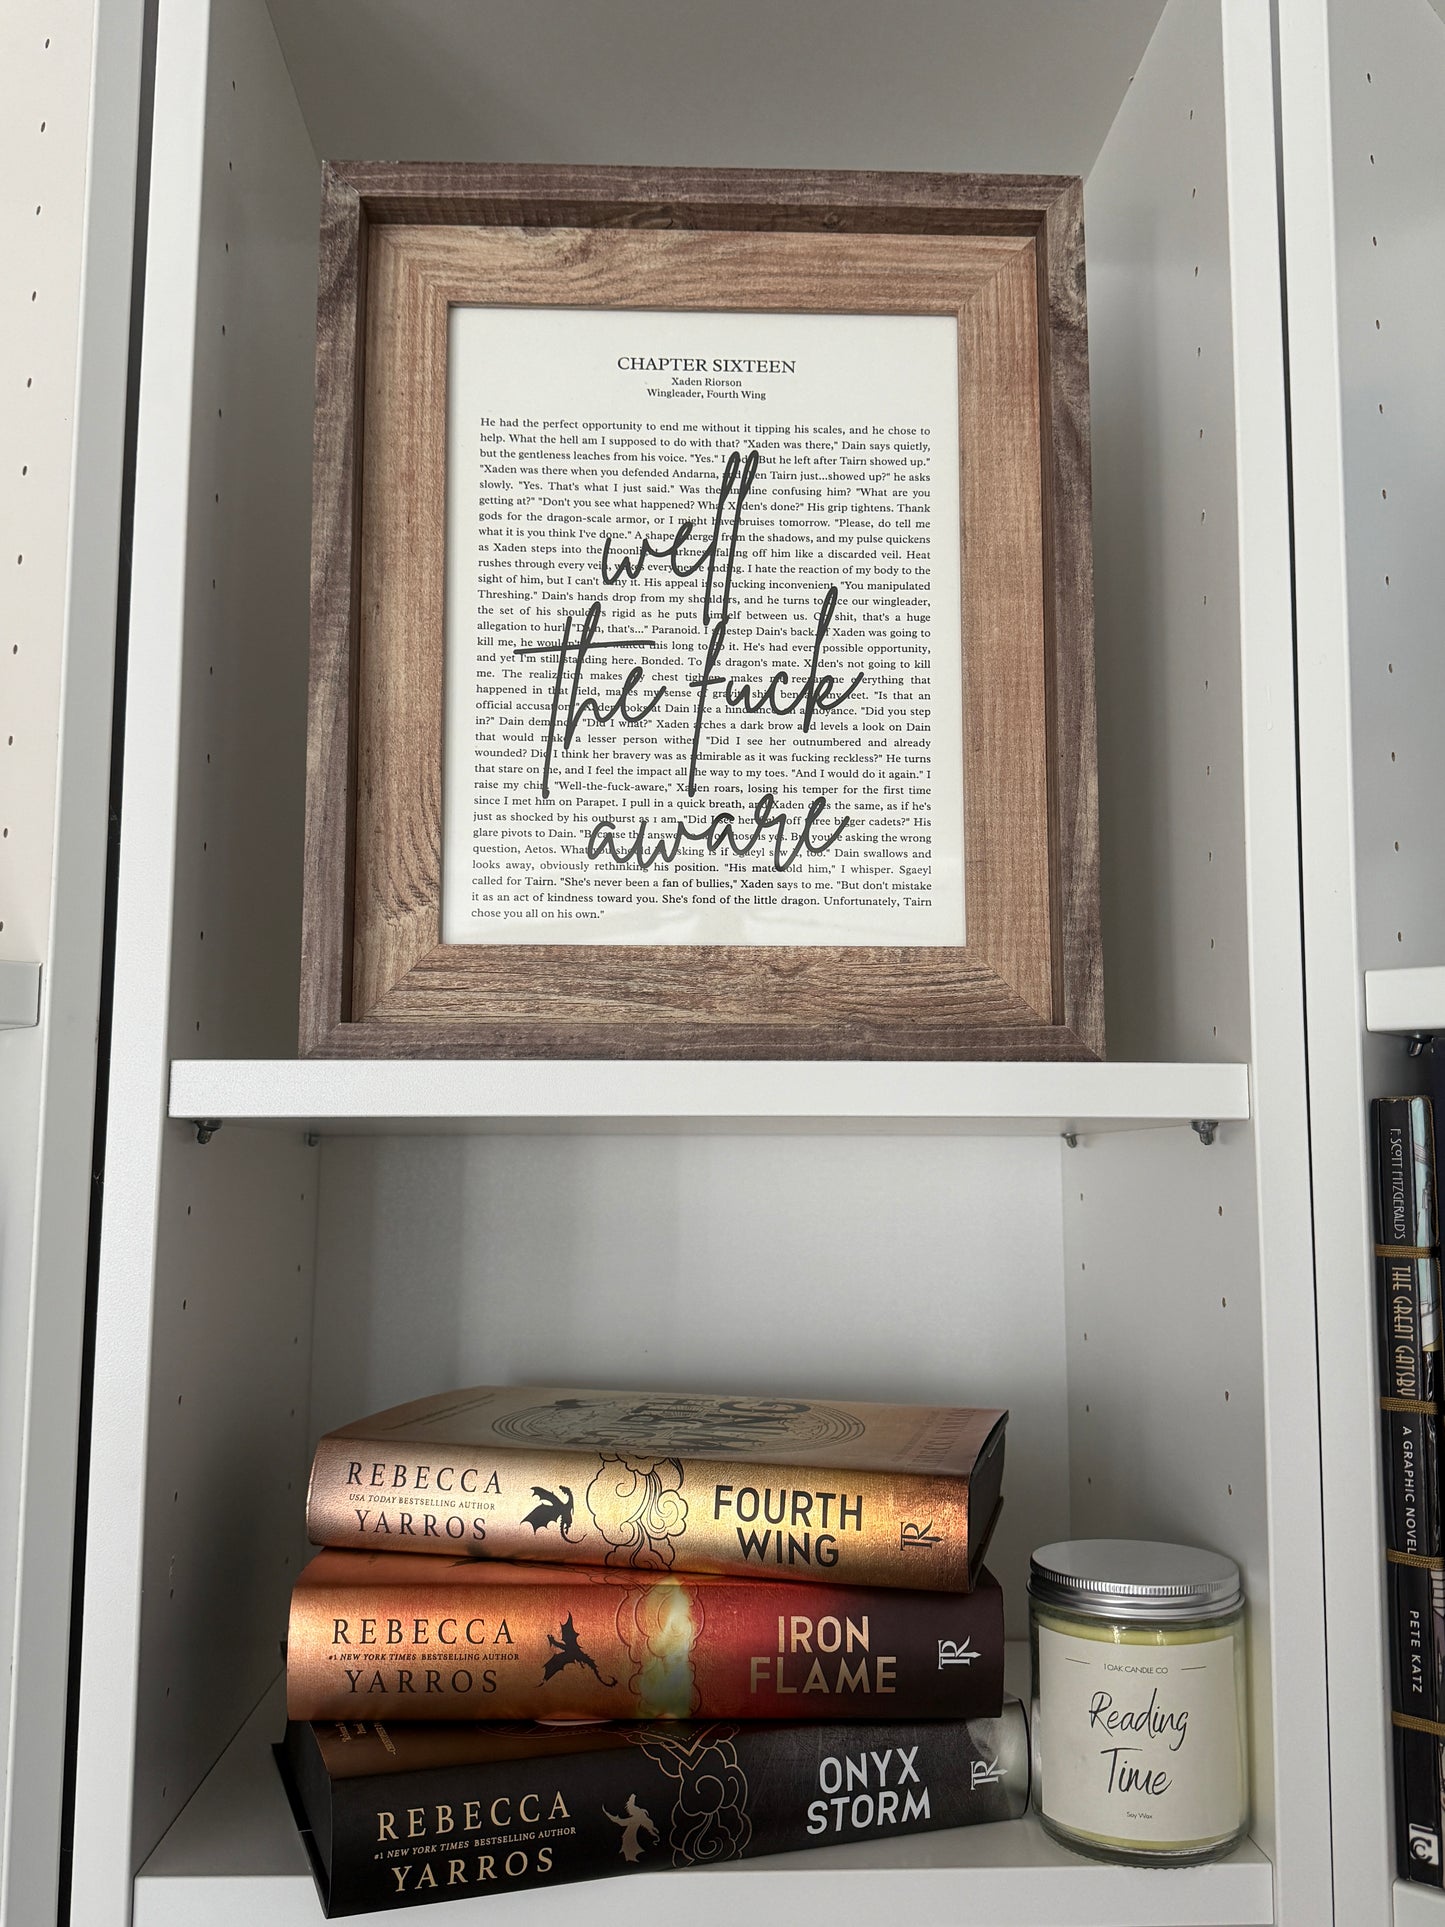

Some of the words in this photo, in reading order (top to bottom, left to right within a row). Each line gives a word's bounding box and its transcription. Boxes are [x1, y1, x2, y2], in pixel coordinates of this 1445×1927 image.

[617, 356, 708, 372] CHAPTER
[712, 358, 797, 374] SIXTEEN
[671, 377, 702, 387] Xaden
[704, 377, 742, 387] Riorson
[647, 388, 704, 399] Wingleader,
[706, 389, 739, 399] Fourth
[741, 390, 767, 401] Wing
[480, 417, 496, 427] He
[499, 418, 519, 427] had
[522, 418, 539, 428] the
[542, 419, 579, 431] perfect
[582, 419, 643, 432] opportunity
[646, 421, 657, 430] to
[659, 421, 680, 430] end
[701, 422, 741, 432] without
[743, 423, 752, 432] it
[755, 423, 791, 435] tipping
[794, 424, 810, 433] his
[813, 424, 846, 435] scales,
[849, 425, 869, 434] and
[872, 425, 885, 435] he
[888, 426, 917, 435] chose
[920, 426, 931, 436] to
[480, 433, 506, 445] help.
[508, 433, 537, 443] What
[540, 434, 557, 444] the
[559, 434, 579, 444] hell
[601, 435, 606, 444] I
[609, 435, 657, 448] supposed
[660, 436, 671, 446] to
[673, 437, 687, 446] do
[689, 437, 712, 447] with
[715, 437, 740, 447] that?
[743, 438, 781, 448] "Xaden
[805, 439, 839, 450] there,"
[841, 440, 867, 450] Dain
[869, 443, 891, 452] says
[893, 441, 931, 453] quietly,
[602, 450, 759, 625] well
[513, 601, 666, 798] the
[688, 587, 864, 798] fuck
[474, 779, 499, 789] raise
[503, 782, 520, 791] my
[554, 780, 672, 792] "Well-the-fuck-aware,"
[714, 785, 744, 793] roars,
[747, 783, 779, 795] losing
[782, 783, 798, 793] his
[801, 783, 839, 796] temper
[843, 784, 859, 794] for
[862, 784, 879, 794] the
[883, 785, 905, 794] first
[908, 785, 932, 795] time
[587, 794, 850, 873] aware
[471, 876, 503, 885] called
[506, 876, 522, 886] for
[524, 876, 557, 886] Tairn.
[560, 877, 591, 886] "She's
[625, 877, 650, 887] been
[662, 878, 680, 887] fan
[682, 878, 695, 888] of
[695, 878, 738, 889] bullies,"
[740, 879, 774, 889] Xaden
[777, 882, 799, 891] says
[801, 879, 812, 889] to
[836, 880, 860, 889] "But
[862, 880, 889, 890] don't
[892, 880, 932, 890] mistake
[471, 892, 480, 901] it
[513, 892, 530, 902] act
[532, 892, 545, 902] of
[547, 893, 594, 903] kindness
[597, 893, 633, 903] toward
[636, 896, 659, 906] you.
[662, 894, 689, 904] She's
[692, 894, 717, 904] fond
[719, 894, 732, 904] of
[733, 895, 751, 904] the
[754, 895, 778, 905] little
[780, 895, 820, 907] dragon.
[823, 896, 900, 908] Unfortunately,
[902, 896, 932, 906] Tairn
[471, 908, 502, 918] chose
[503, 911, 523, 920] you
[525, 908, 539, 918] all
[557, 909, 573, 918] his
[575, 909, 605, 919] own."
[1392, 1171, 1406, 1240] FITZGERALD'S
[1392, 1265, 1412, 1291] THE
[1393, 1295, 1414, 1341] GREAT
[1395, 1345, 1416, 1397] GATSBY
[1402, 1426, 1412, 1435] A
[346, 1461, 503, 1494] REBECCA
[1403, 1441, 1415, 1503] GRAPHIC
[349, 1493, 366, 1502] USA
[368, 1494, 397, 1504] TODAY
[398, 1497, 456, 1508] BESTSELLING
[458, 1501, 496, 1511] AUTHOR
[714, 1484, 863, 1532] FOURTH
[354, 1509, 486, 1541] YARROS
[1406, 1507, 1417, 1554] NOVEL
[736, 1526, 840, 1568] WING
[331, 1618, 515, 1645] REBECCA
[778, 1615, 870, 1653] IRON
[1410, 1610, 1421, 1648] PETE
[328, 1653, 338, 1661] #1
[340, 1653, 361, 1661] NEW
[363, 1653, 387, 1661] YORK
[388, 1653, 417, 1661] TIMES
[421, 1653, 480, 1661] BESTSELLING
[482, 1653, 520, 1661] AUTHOR
[750, 1656, 897, 1694] FLAME
[1107, 1664, 1123, 1672] OAK
[1124, 1665, 1154, 1674] CANDLE
[1155, 1666, 1169, 1674] CO
[1411, 1654, 1423, 1693] KATZ
[344, 1669, 498, 1694] YARROS
[1088, 1687, 1189, 1751] Reading
[819, 1746, 921, 1794] ONYX
[1100, 1747, 1172, 1795] Time
[376, 1790, 571, 1842] REBECCA
[806, 1786, 931, 1835] STORM
[1126, 1811, 1138, 1819] Soy
[1138, 1811, 1153, 1819] Wax
[374, 1852, 384, 1860] #1
[387, 1848, 410, 1859] NEW
[412, 1844, 437, 1855] YORK
[440, 1840, 470, 1851] TIMES
[474, 1832, 536, 1847] BESTSELLING
[538, 1826, 577, 1839] AUTHOR
[391, 1847, 554, 1893] YARROS
